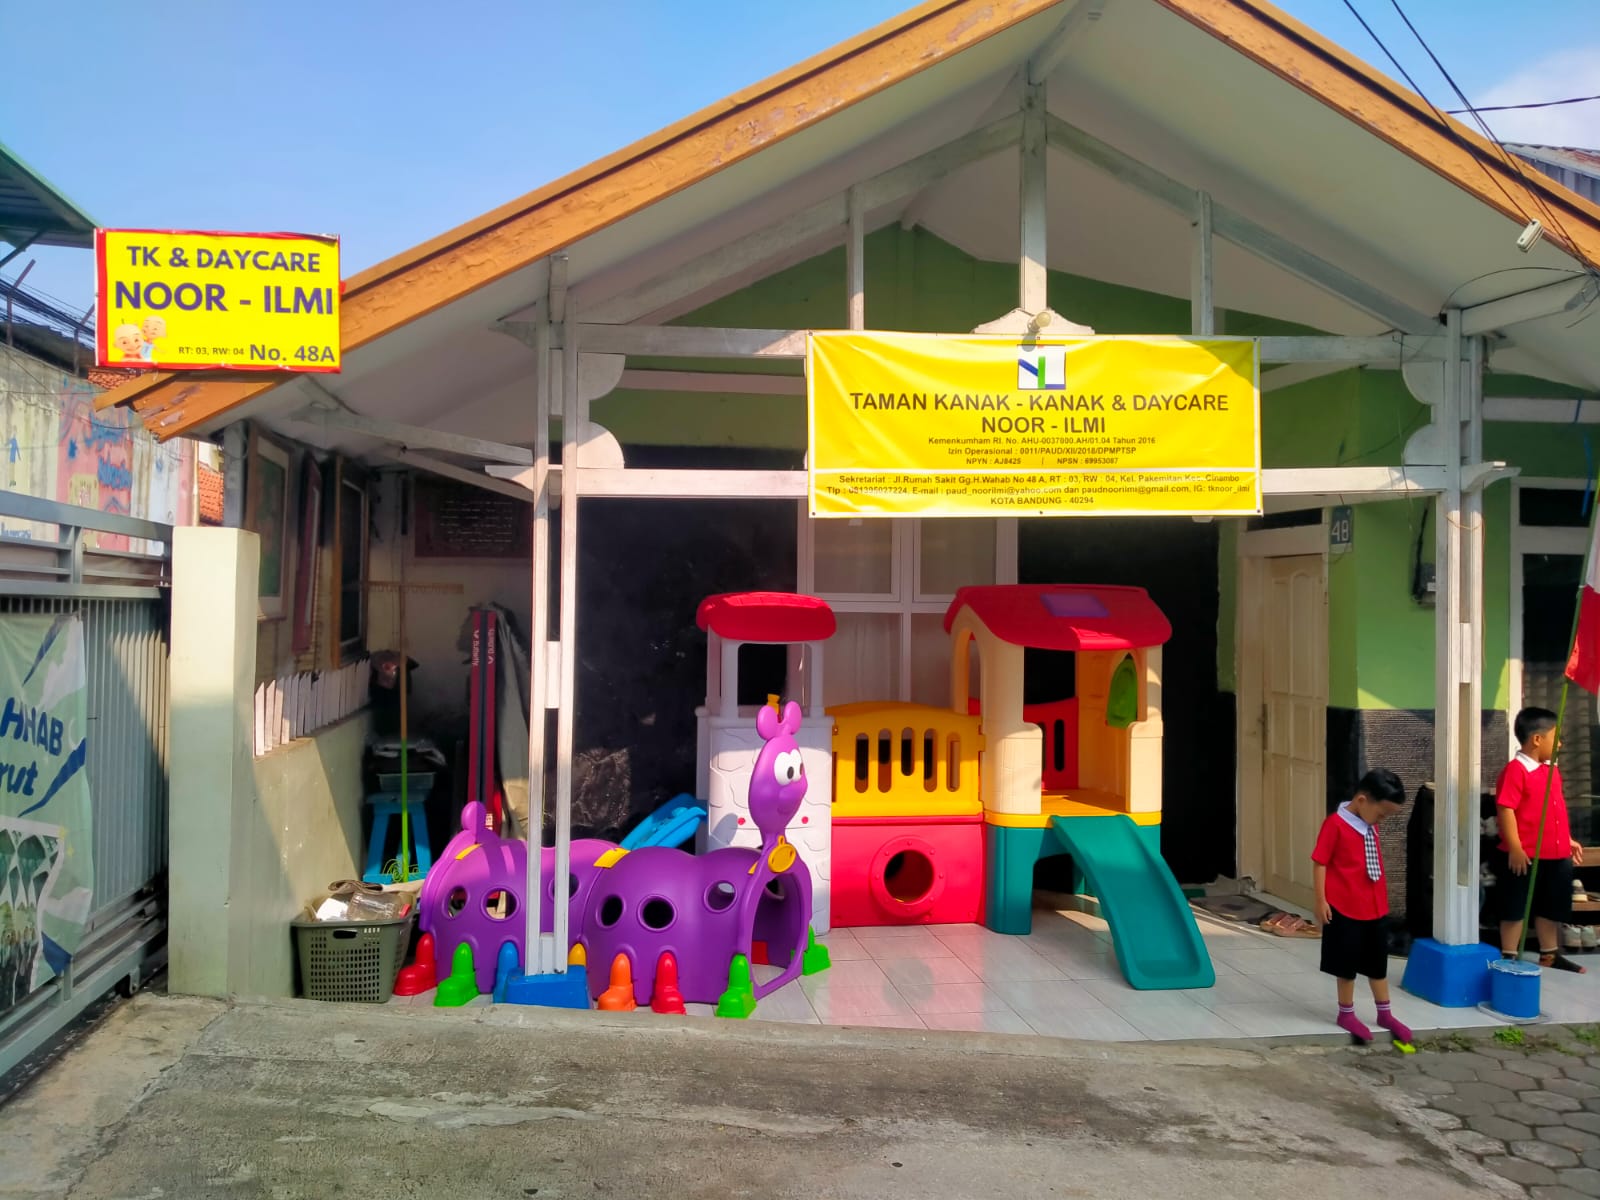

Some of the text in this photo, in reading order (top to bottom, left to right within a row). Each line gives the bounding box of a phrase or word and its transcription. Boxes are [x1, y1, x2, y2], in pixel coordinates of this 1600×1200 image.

[126, 246, 320, 272] TK & DAYCARE
[115, 281, 228, 311] NOOR
[264, 286, 333, 314] ILMI
[212, 347, 230, 355] RW:
[233, 347, 244, 356] 04
[250, 344, 287, 361] No.
[294, 345, 335, 362] 48A
[850, 392, 927, 410] TAMAN
[934, 393, 1011, 411] KANAK
[1029, 394, 1105, 411] KANAK
[1111, 394, 1127, 411] &
[1133, 394, 1229, 411] DAYCARE
[982, 416, 1045, 433] NOOR
[1064, 417, 1105, 433] ILMI
[928, 437, 990, 445] Kemenkumham
[1113, 436, 1136, 444] Tahun
[1138, 436, 1156, 444] 2016
[948, 447, 962, 455] Izin
[965, 447, 1013, 456] Operasional
[839, 475, 886, 483] Sekretariat
[935, 475, 956, 483] Sakit
[1049, 475, 1061, 483] RT
[1205, 474, 1240, 482] Cinambo
[912, 486, 939, 494] E-mail
[1064, 486, 1079, 494] dan
[1331, 519, 1349, 542] 48
